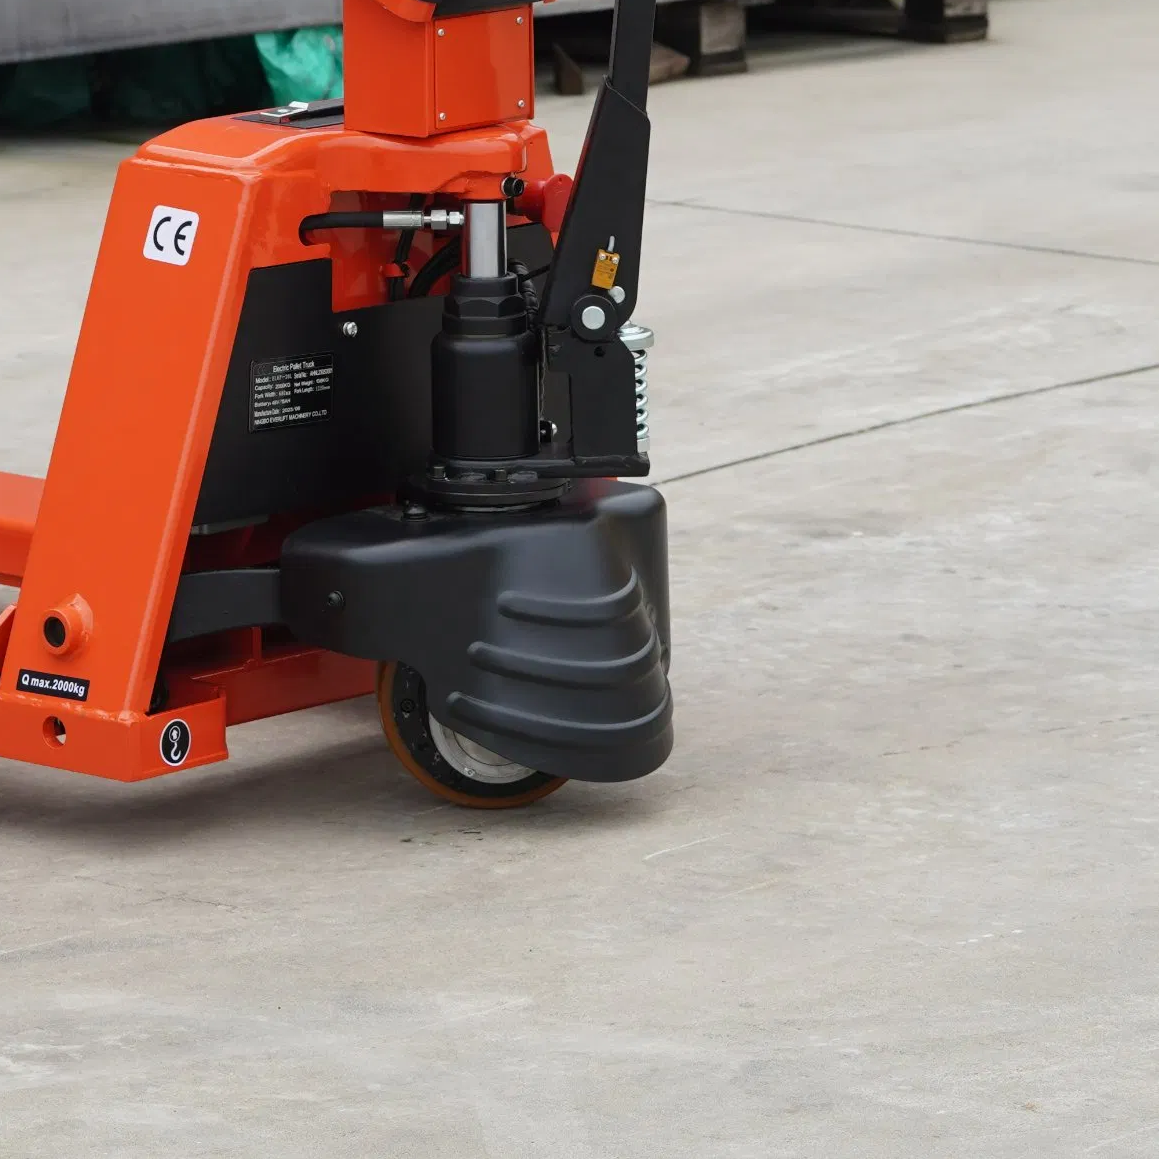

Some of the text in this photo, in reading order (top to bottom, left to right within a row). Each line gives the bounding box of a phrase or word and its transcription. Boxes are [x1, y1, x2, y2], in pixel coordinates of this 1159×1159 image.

[153, 216, 192, 256] CE
[273, 364, 289, 372] Electric
[289, 412, 311, 420] MACHINERY
[21, 673, 85, 697] Q max.2000kg
